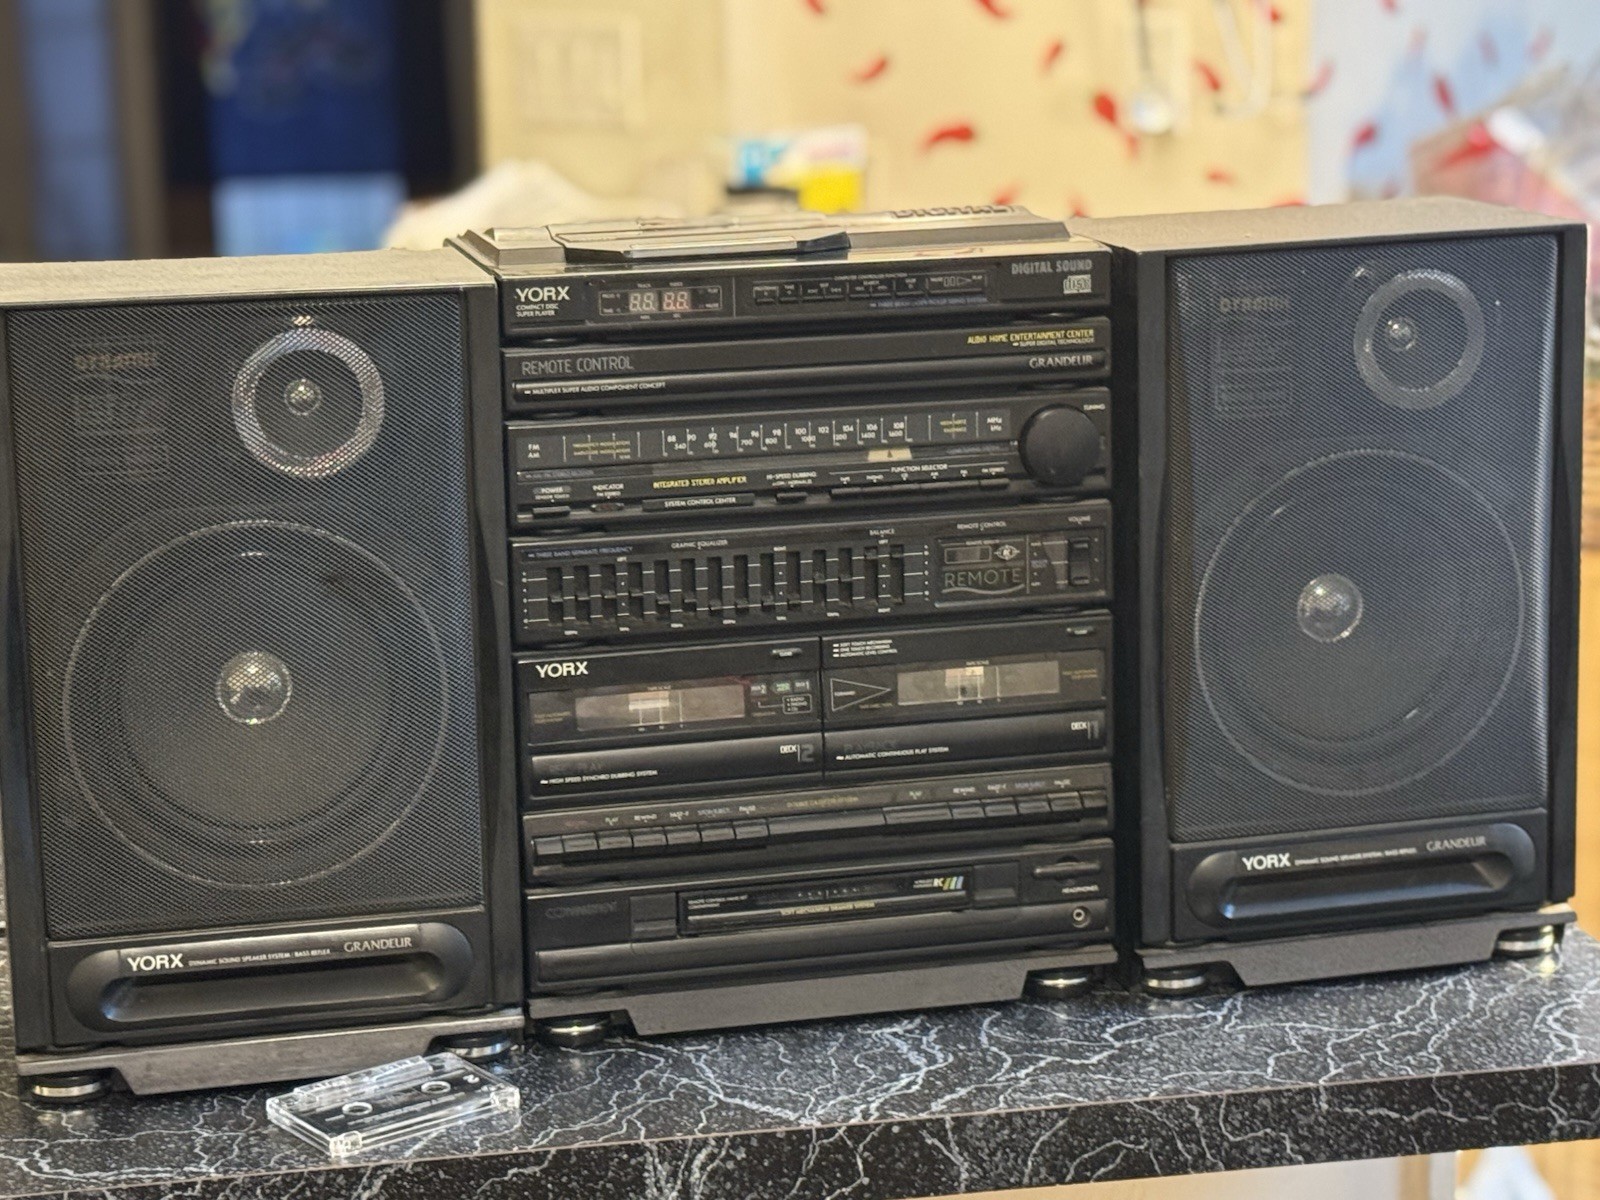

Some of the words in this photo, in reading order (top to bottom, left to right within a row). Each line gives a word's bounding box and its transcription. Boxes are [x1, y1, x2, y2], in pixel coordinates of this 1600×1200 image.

[1011, 261, 1053, 275] DIGITAL
[1056, 259, 1092, 272] SOUND
[515, 286, 570, 302] YORX
[967, 335, 987, 344] AUDIO
[989, 333, 1008, 343] HOME
[1010, 330, 1065, 342] ENTERTAINMENT
[1066, 329, 1094, 339] CENTER
[521, 359, 572, 376] REMOTE
[576, 355, 634, 373] CONTROL
[1029, 354, 1093, 369] GRANDEUR
[600, 383, 639, 391] COMPONENT
[639, 381, 666, 389] CONCEPT
[891, 465, 921, 473] FUNCTION
[921, 463, 948, 471] SELECTOR
[592, 483, 624, 491] INDICATOR
[653, 480, 690, 489] INTEGRATED
[691, 478, 715, 487] STEREO
[716, 476, 747, 485] AMPLIFIER
[664, 500, 686, 508] SYSTEM
[944, 568, 1022, 587] REMOTE
[535, 661, 588, 678] YORX
[1071, 721, 1087, 730] DECK
[780, 745, 797, 754] DECK
[845, 752, 876, 760] AUTOMATIC
[877, 749, 914, 758] CONTINUOUS
[1241, 853, 1290, 871] YORX
[1426, 836, 1486, 852] GRANDEUR
[127, 953, 183, 971] YORX
[343, 937, 412, 953] GRANDEUR
